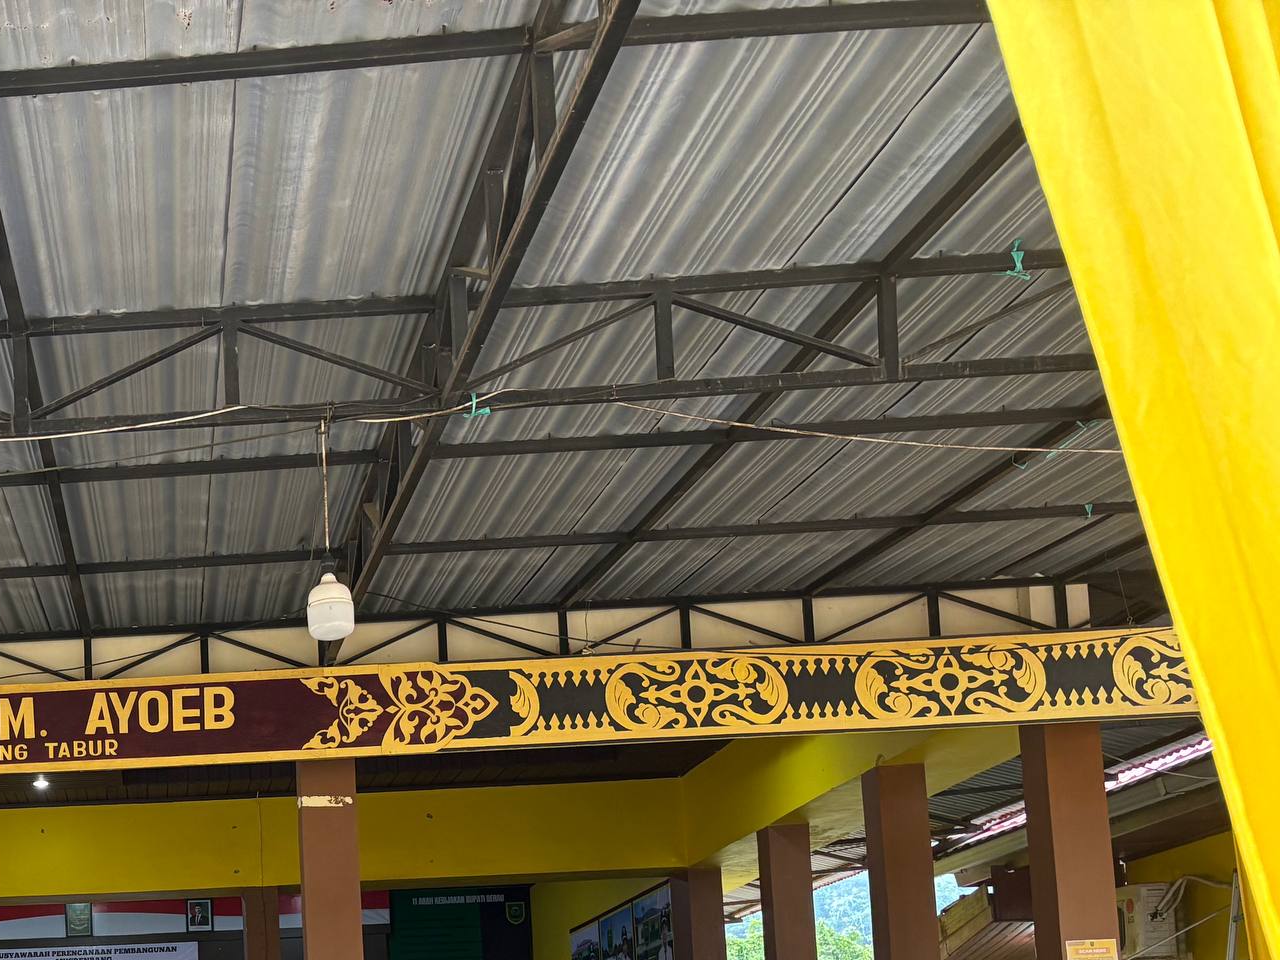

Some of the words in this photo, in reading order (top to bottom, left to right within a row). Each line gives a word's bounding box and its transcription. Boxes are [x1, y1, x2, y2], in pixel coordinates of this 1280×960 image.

[85, 686, 236, 735] AYOEB
[45, 738, 119, 758] TABUR
[51, 948, 112, 958] PERENCANAAN
[113, 945, 178, 955] PEMBANGUNAN
